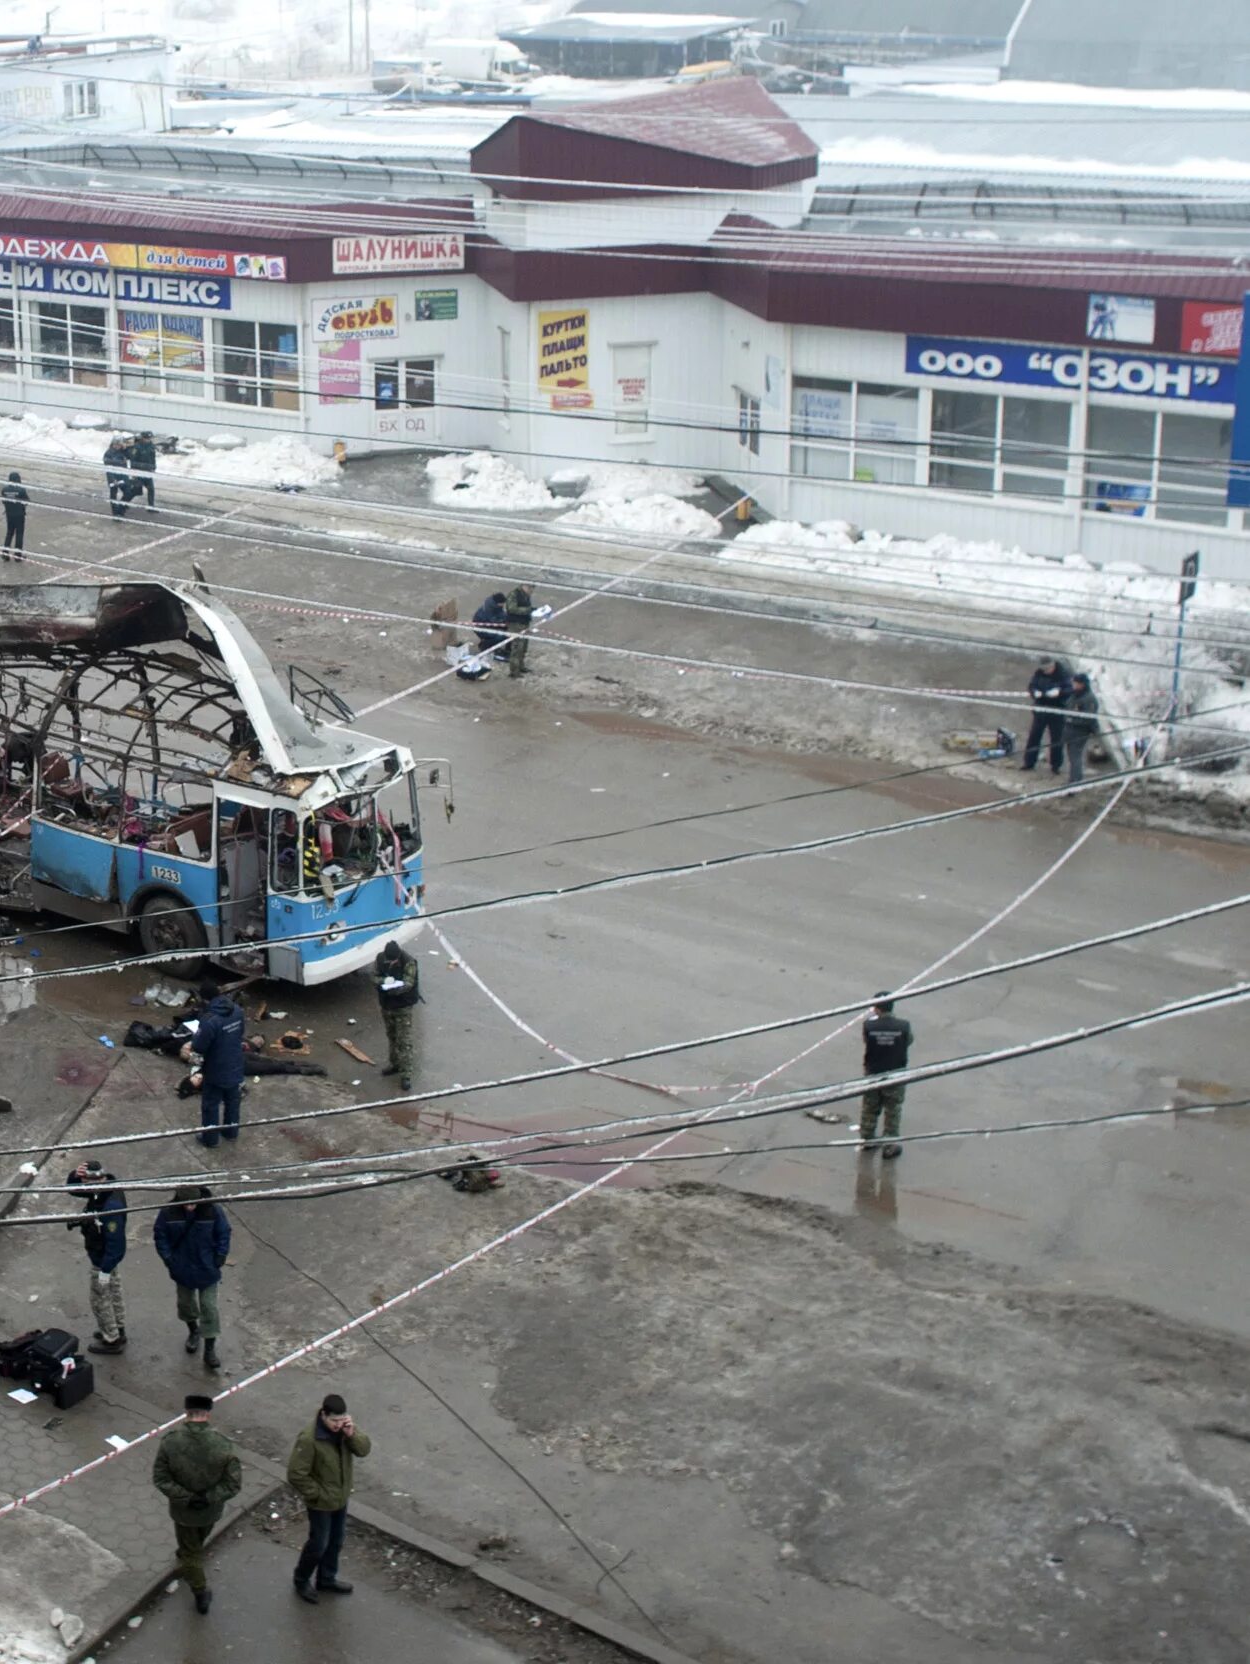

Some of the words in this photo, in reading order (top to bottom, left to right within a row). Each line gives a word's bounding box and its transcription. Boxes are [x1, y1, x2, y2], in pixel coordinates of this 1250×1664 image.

[146, 251, 172, 265] для
[176, 252, 227, 270] детей
[336, 237, 461, 262] ШАЛУНИШКА
[52, 268, 221, 306] КОМПЛЕКС
[125, 310, 202, 340] РАСПОДАЖА
[317, 299, 363, 333] ДЕТСКАЯ
[542, 314, 586, 338] КУРТКИ
[334, 329, 395, 339] ПОДРОСТКОВАЯ
[542, 335, 585, 357] ПЛАЩИ
[540, 355, 588, 379] ПАЛЬТО
[918, 350, 1003, 378] ООО
[154, 866, 179, 883] 1233
